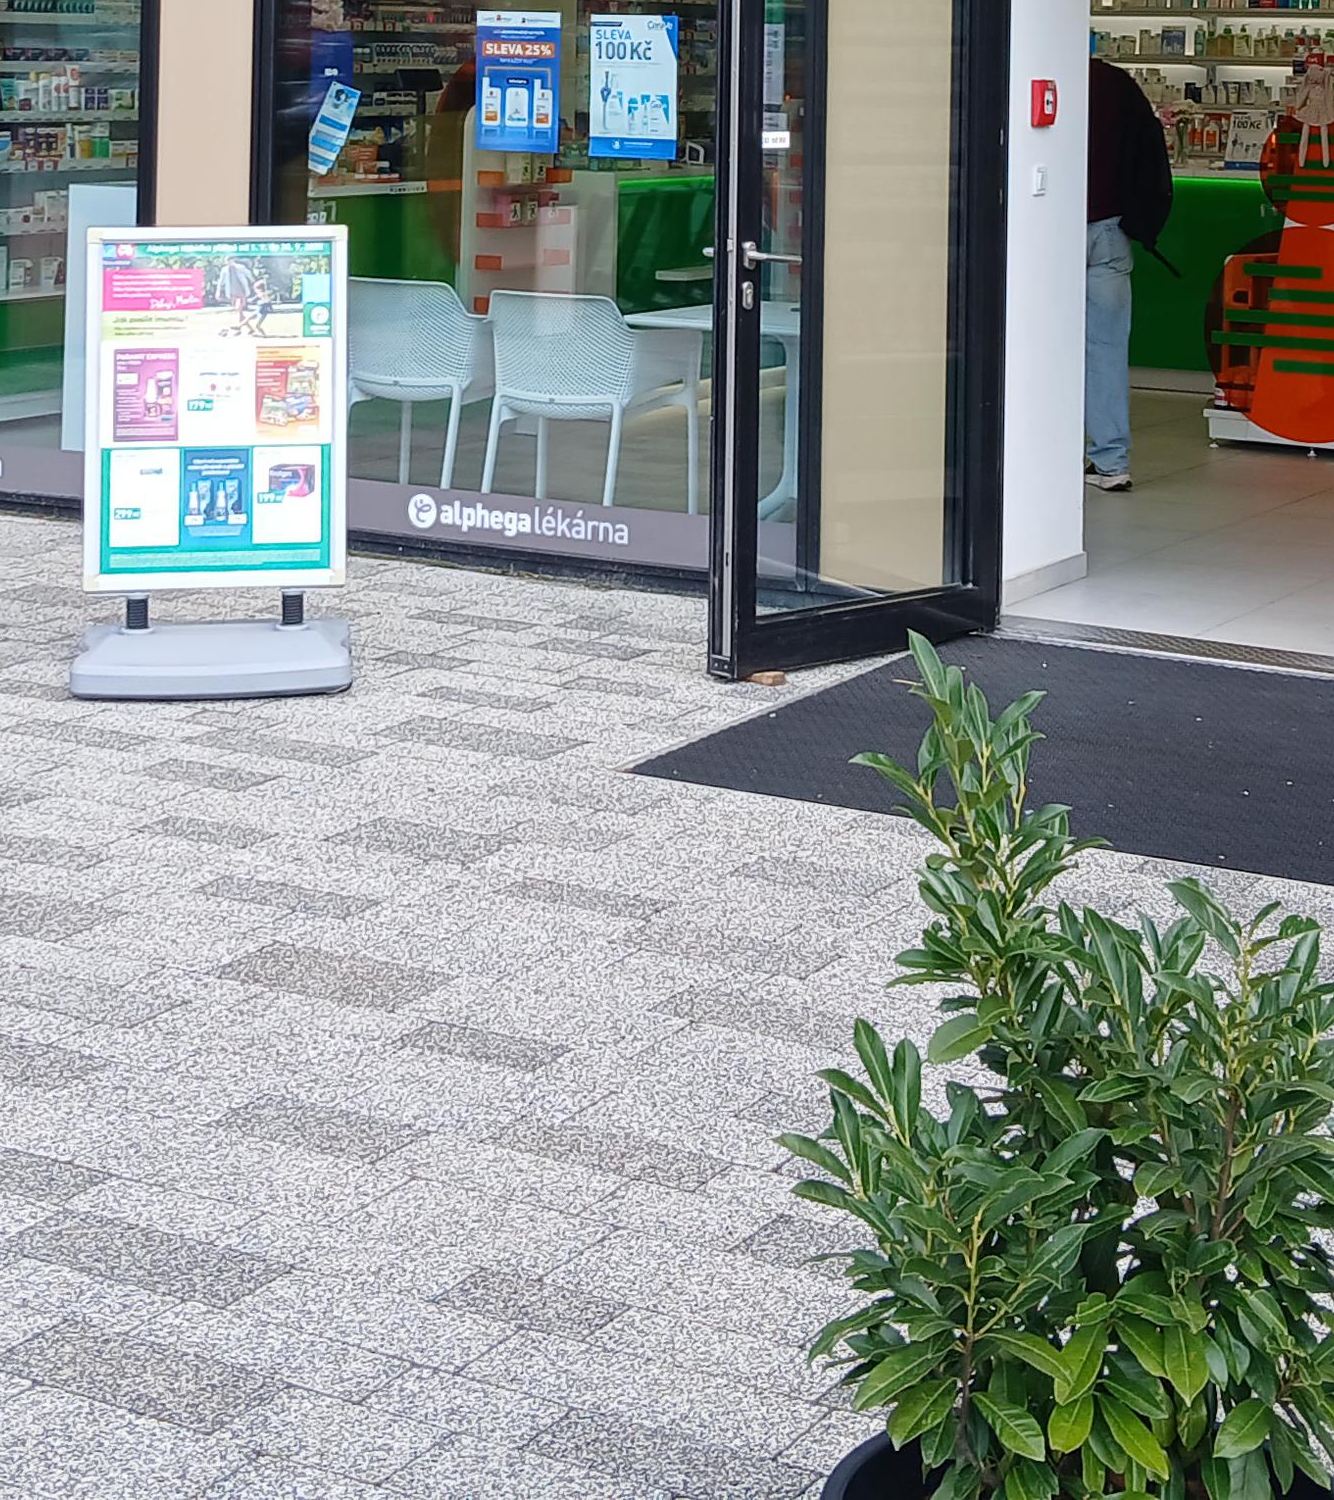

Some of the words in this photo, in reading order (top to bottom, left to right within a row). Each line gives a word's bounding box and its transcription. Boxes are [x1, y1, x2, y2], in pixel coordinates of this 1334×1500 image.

[595, 29, 632, 40] SLEVA
[486, 43, 524, 55] SLEVA
[525, 44, 552, 56] 25%
[595, 41, 627, 60] 100
[630, 40, 652, 61] Kč
